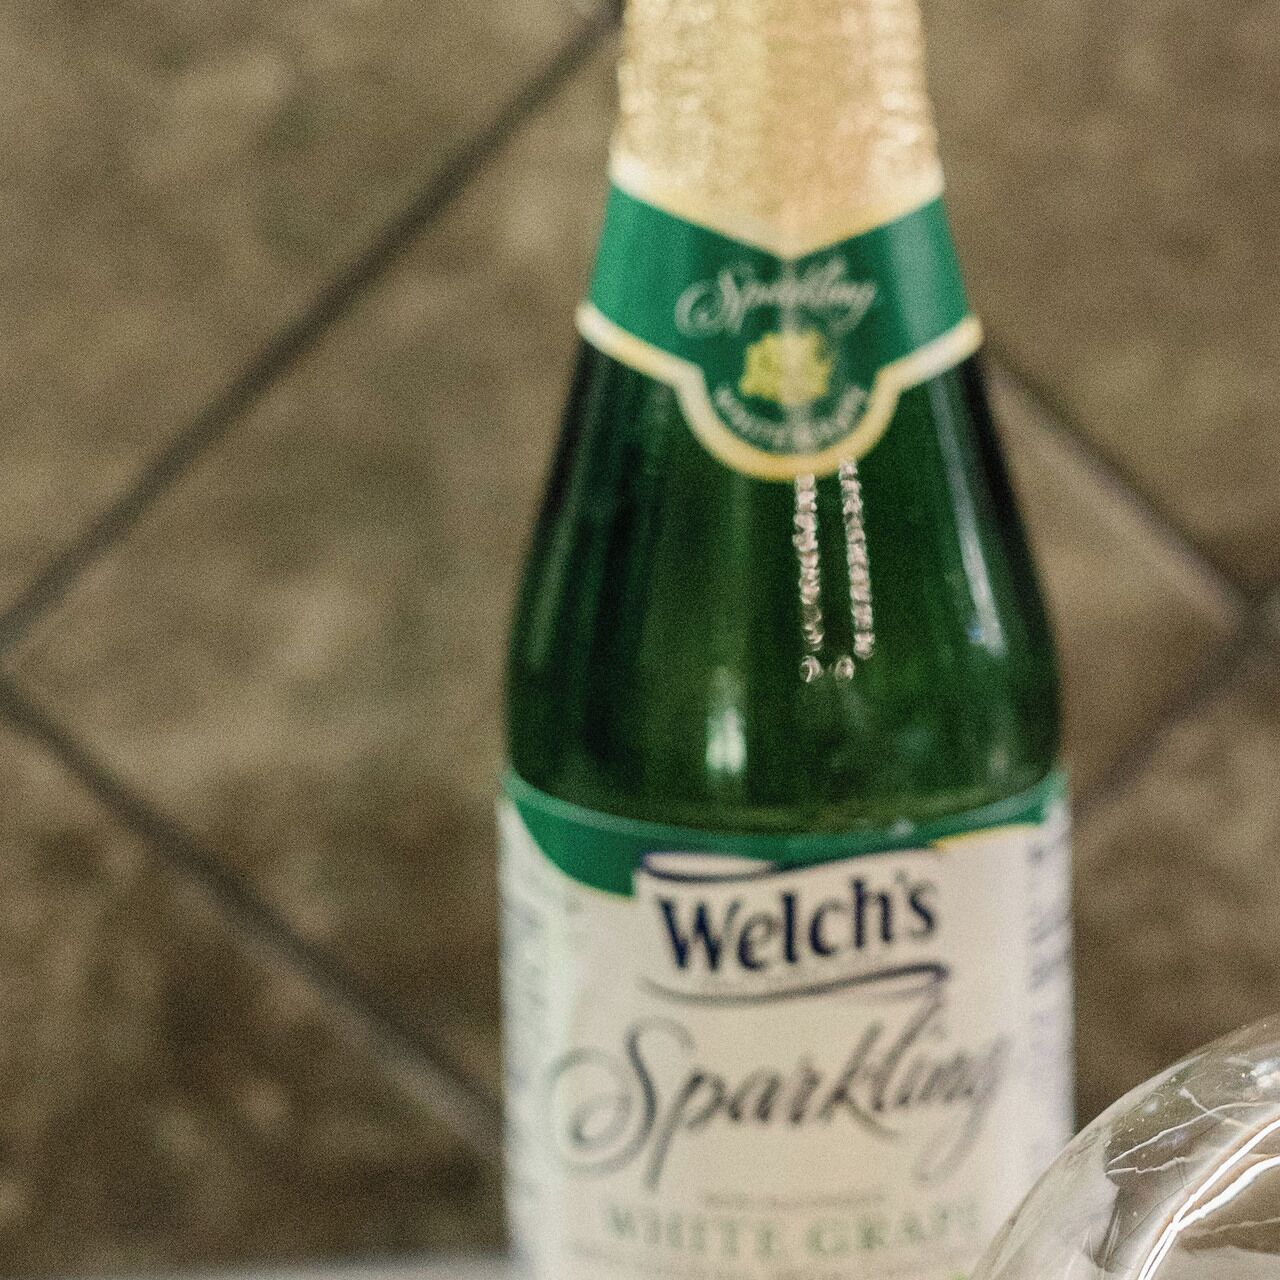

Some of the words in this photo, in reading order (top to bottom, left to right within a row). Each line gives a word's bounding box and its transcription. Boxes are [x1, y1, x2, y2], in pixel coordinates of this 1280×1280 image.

[655, 871, 939, 973] Welch's
[545, 1000, 1012, 1192] Sparkling
[606, 1201, 780, 1261] WHITE
